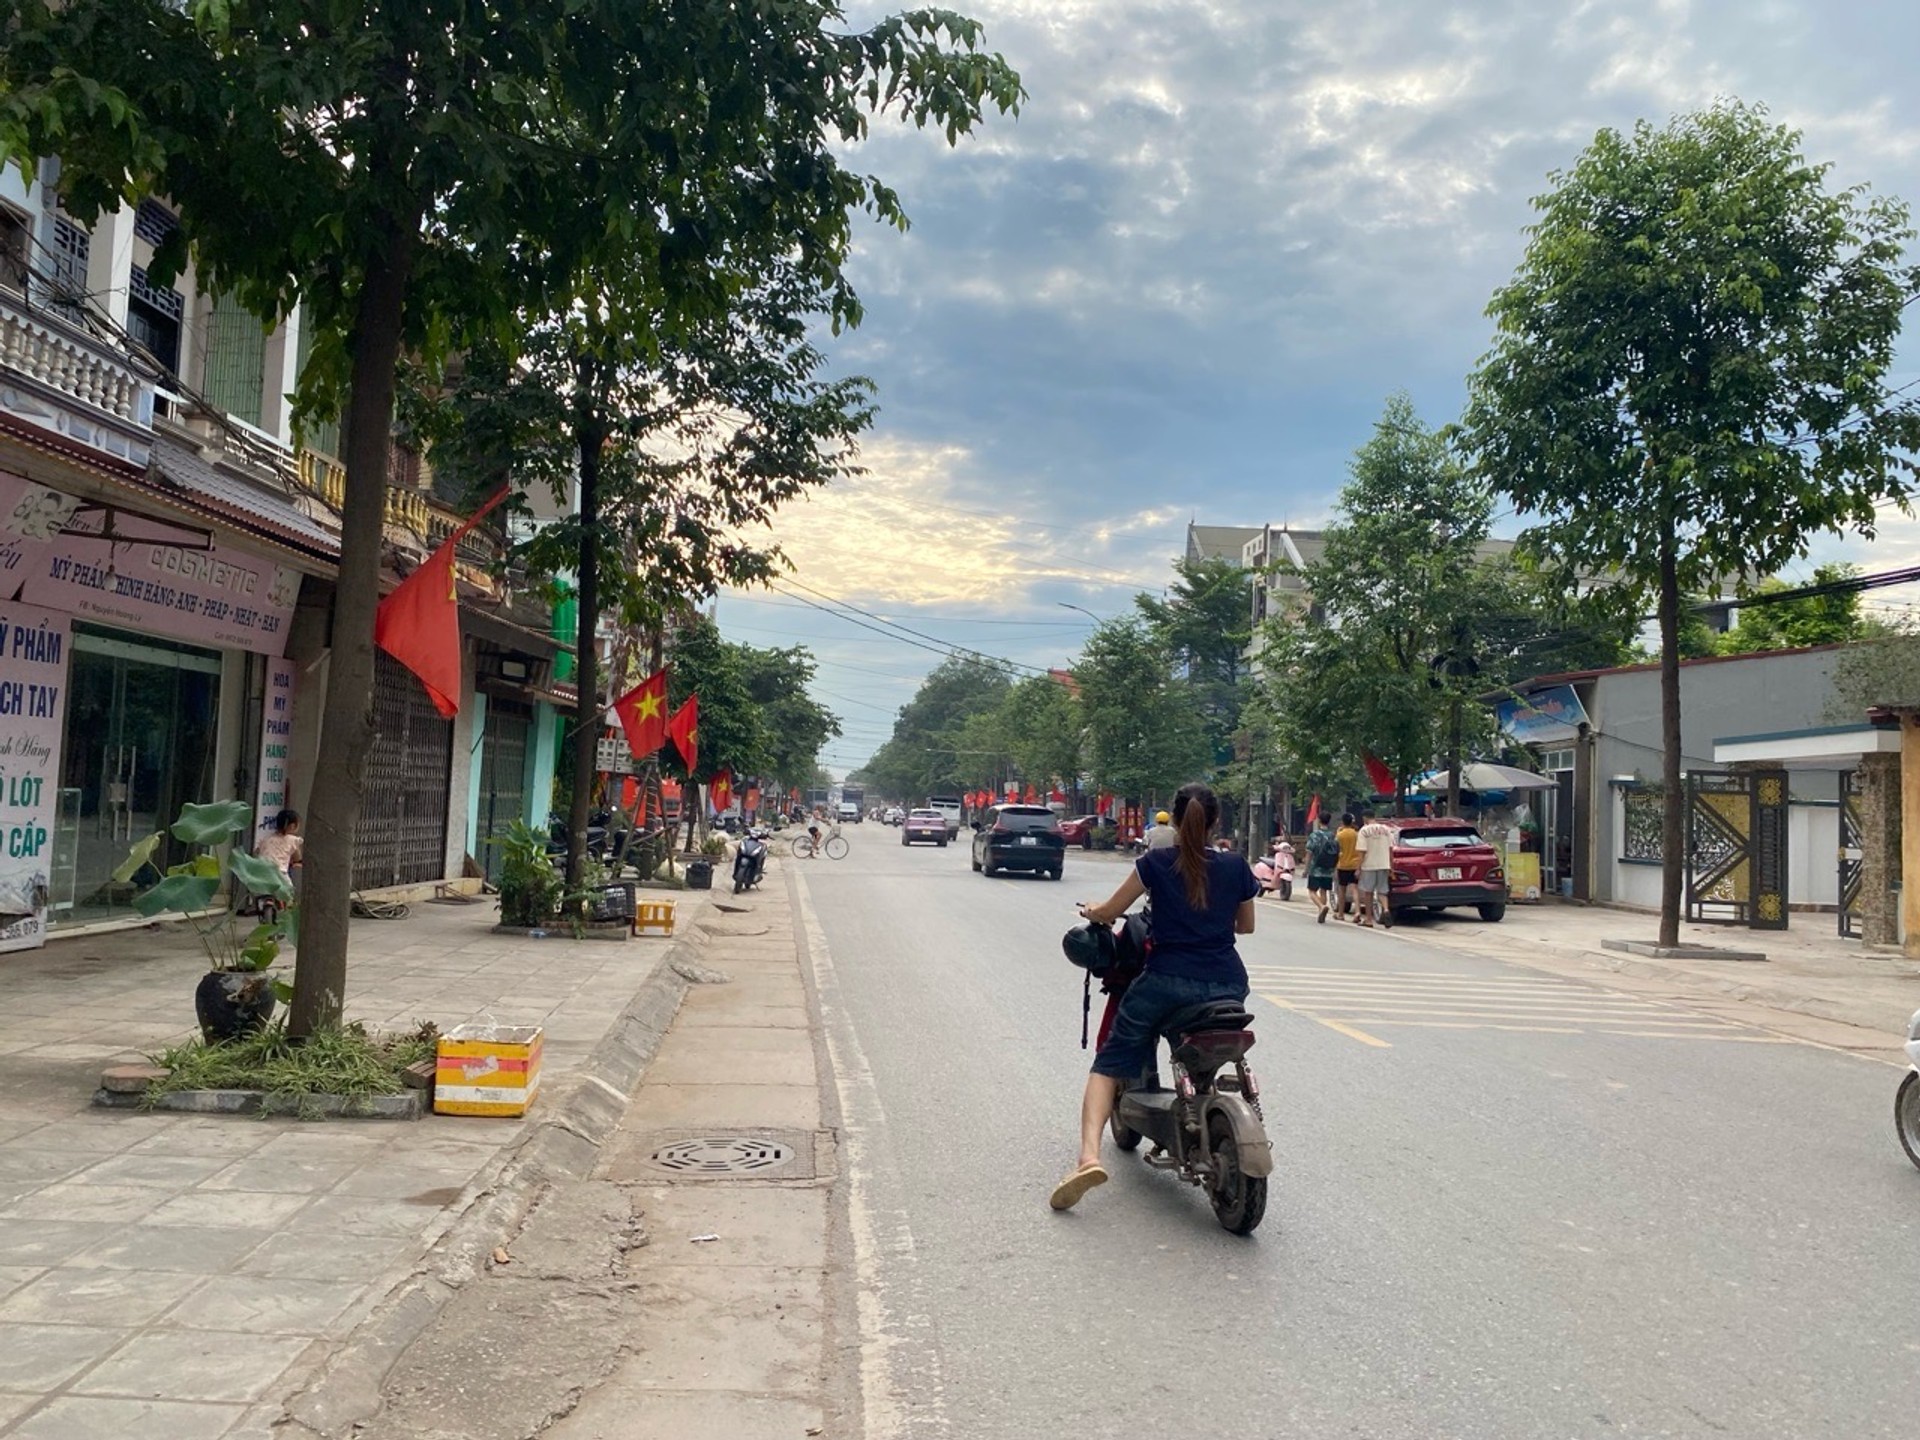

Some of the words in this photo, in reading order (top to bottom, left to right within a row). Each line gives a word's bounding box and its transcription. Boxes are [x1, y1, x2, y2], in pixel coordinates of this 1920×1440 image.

[108, 570, 145, 600] HÍNH
[174, 591, 199, 614] ANH
[12, 617, 62, 665] PHẨM
[0, 681, 23, 715] CH
[29, 684, 58, 718] TAY
[9, 771, 44, 807] LÓT
[9, 817, 47, 858] CẤP
